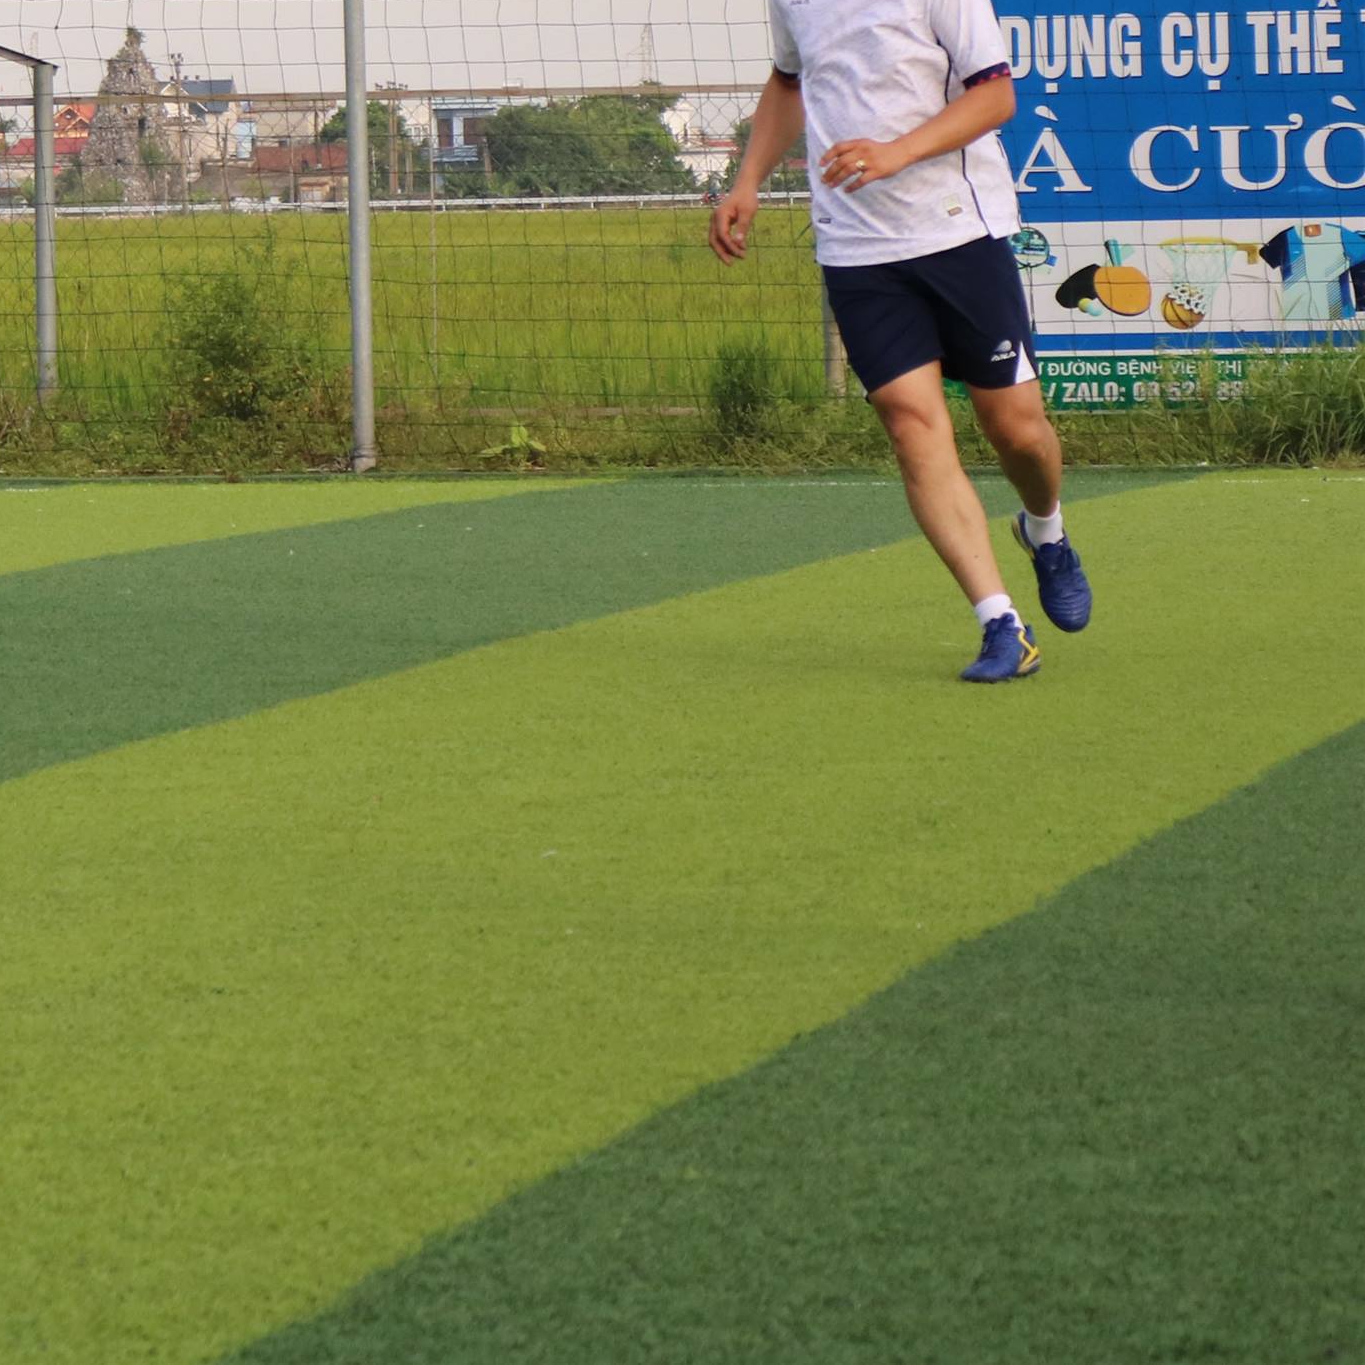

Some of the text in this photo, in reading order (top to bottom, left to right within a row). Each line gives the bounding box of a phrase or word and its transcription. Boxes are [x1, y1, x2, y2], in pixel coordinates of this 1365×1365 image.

[999, 13, 1142, 94] DỤNG
[1161, 11, 1230, 91] CỤ
[1048, 359, 1111, 376] ĐƯỜNG
[1062, 381, 1126, 403] ZALO:
